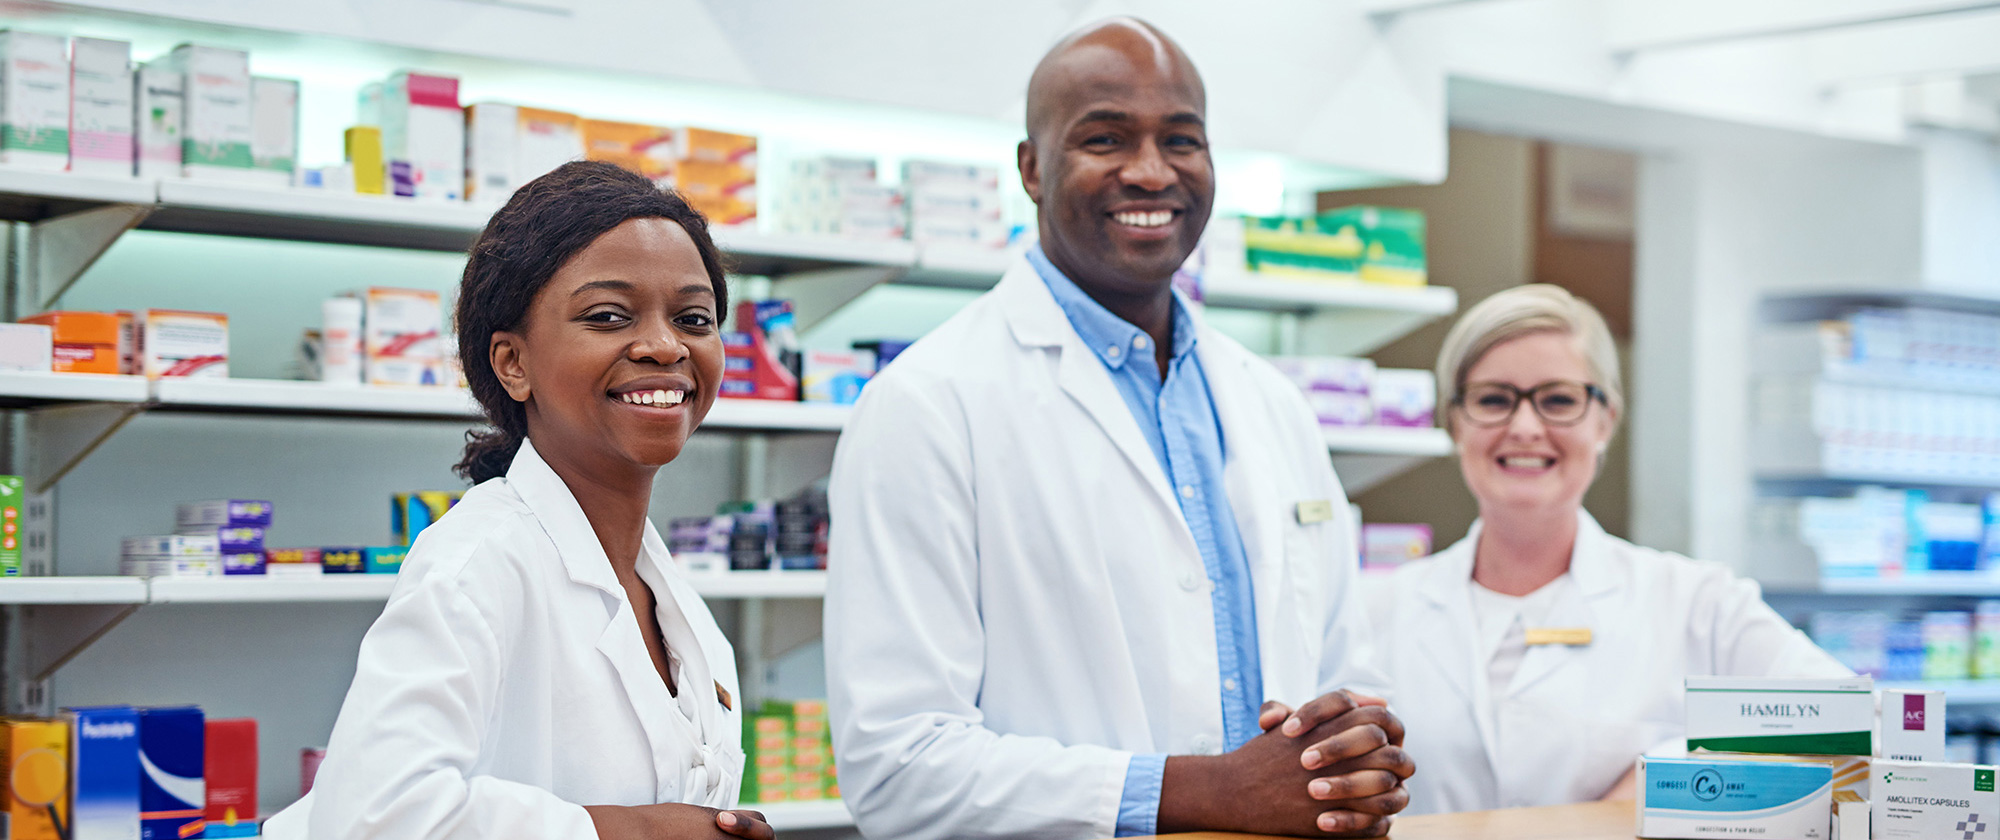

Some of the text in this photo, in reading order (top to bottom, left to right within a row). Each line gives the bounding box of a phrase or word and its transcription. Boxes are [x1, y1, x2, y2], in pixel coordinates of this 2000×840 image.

[1740, 703, 1820, 717] HAMILYN
[1656, 780, 1687, 790] CONGEST
[1726, 782, 1745, 791] AWAY
[1886, 795, 1970, 808] AMOLLITEX CAPSULES
